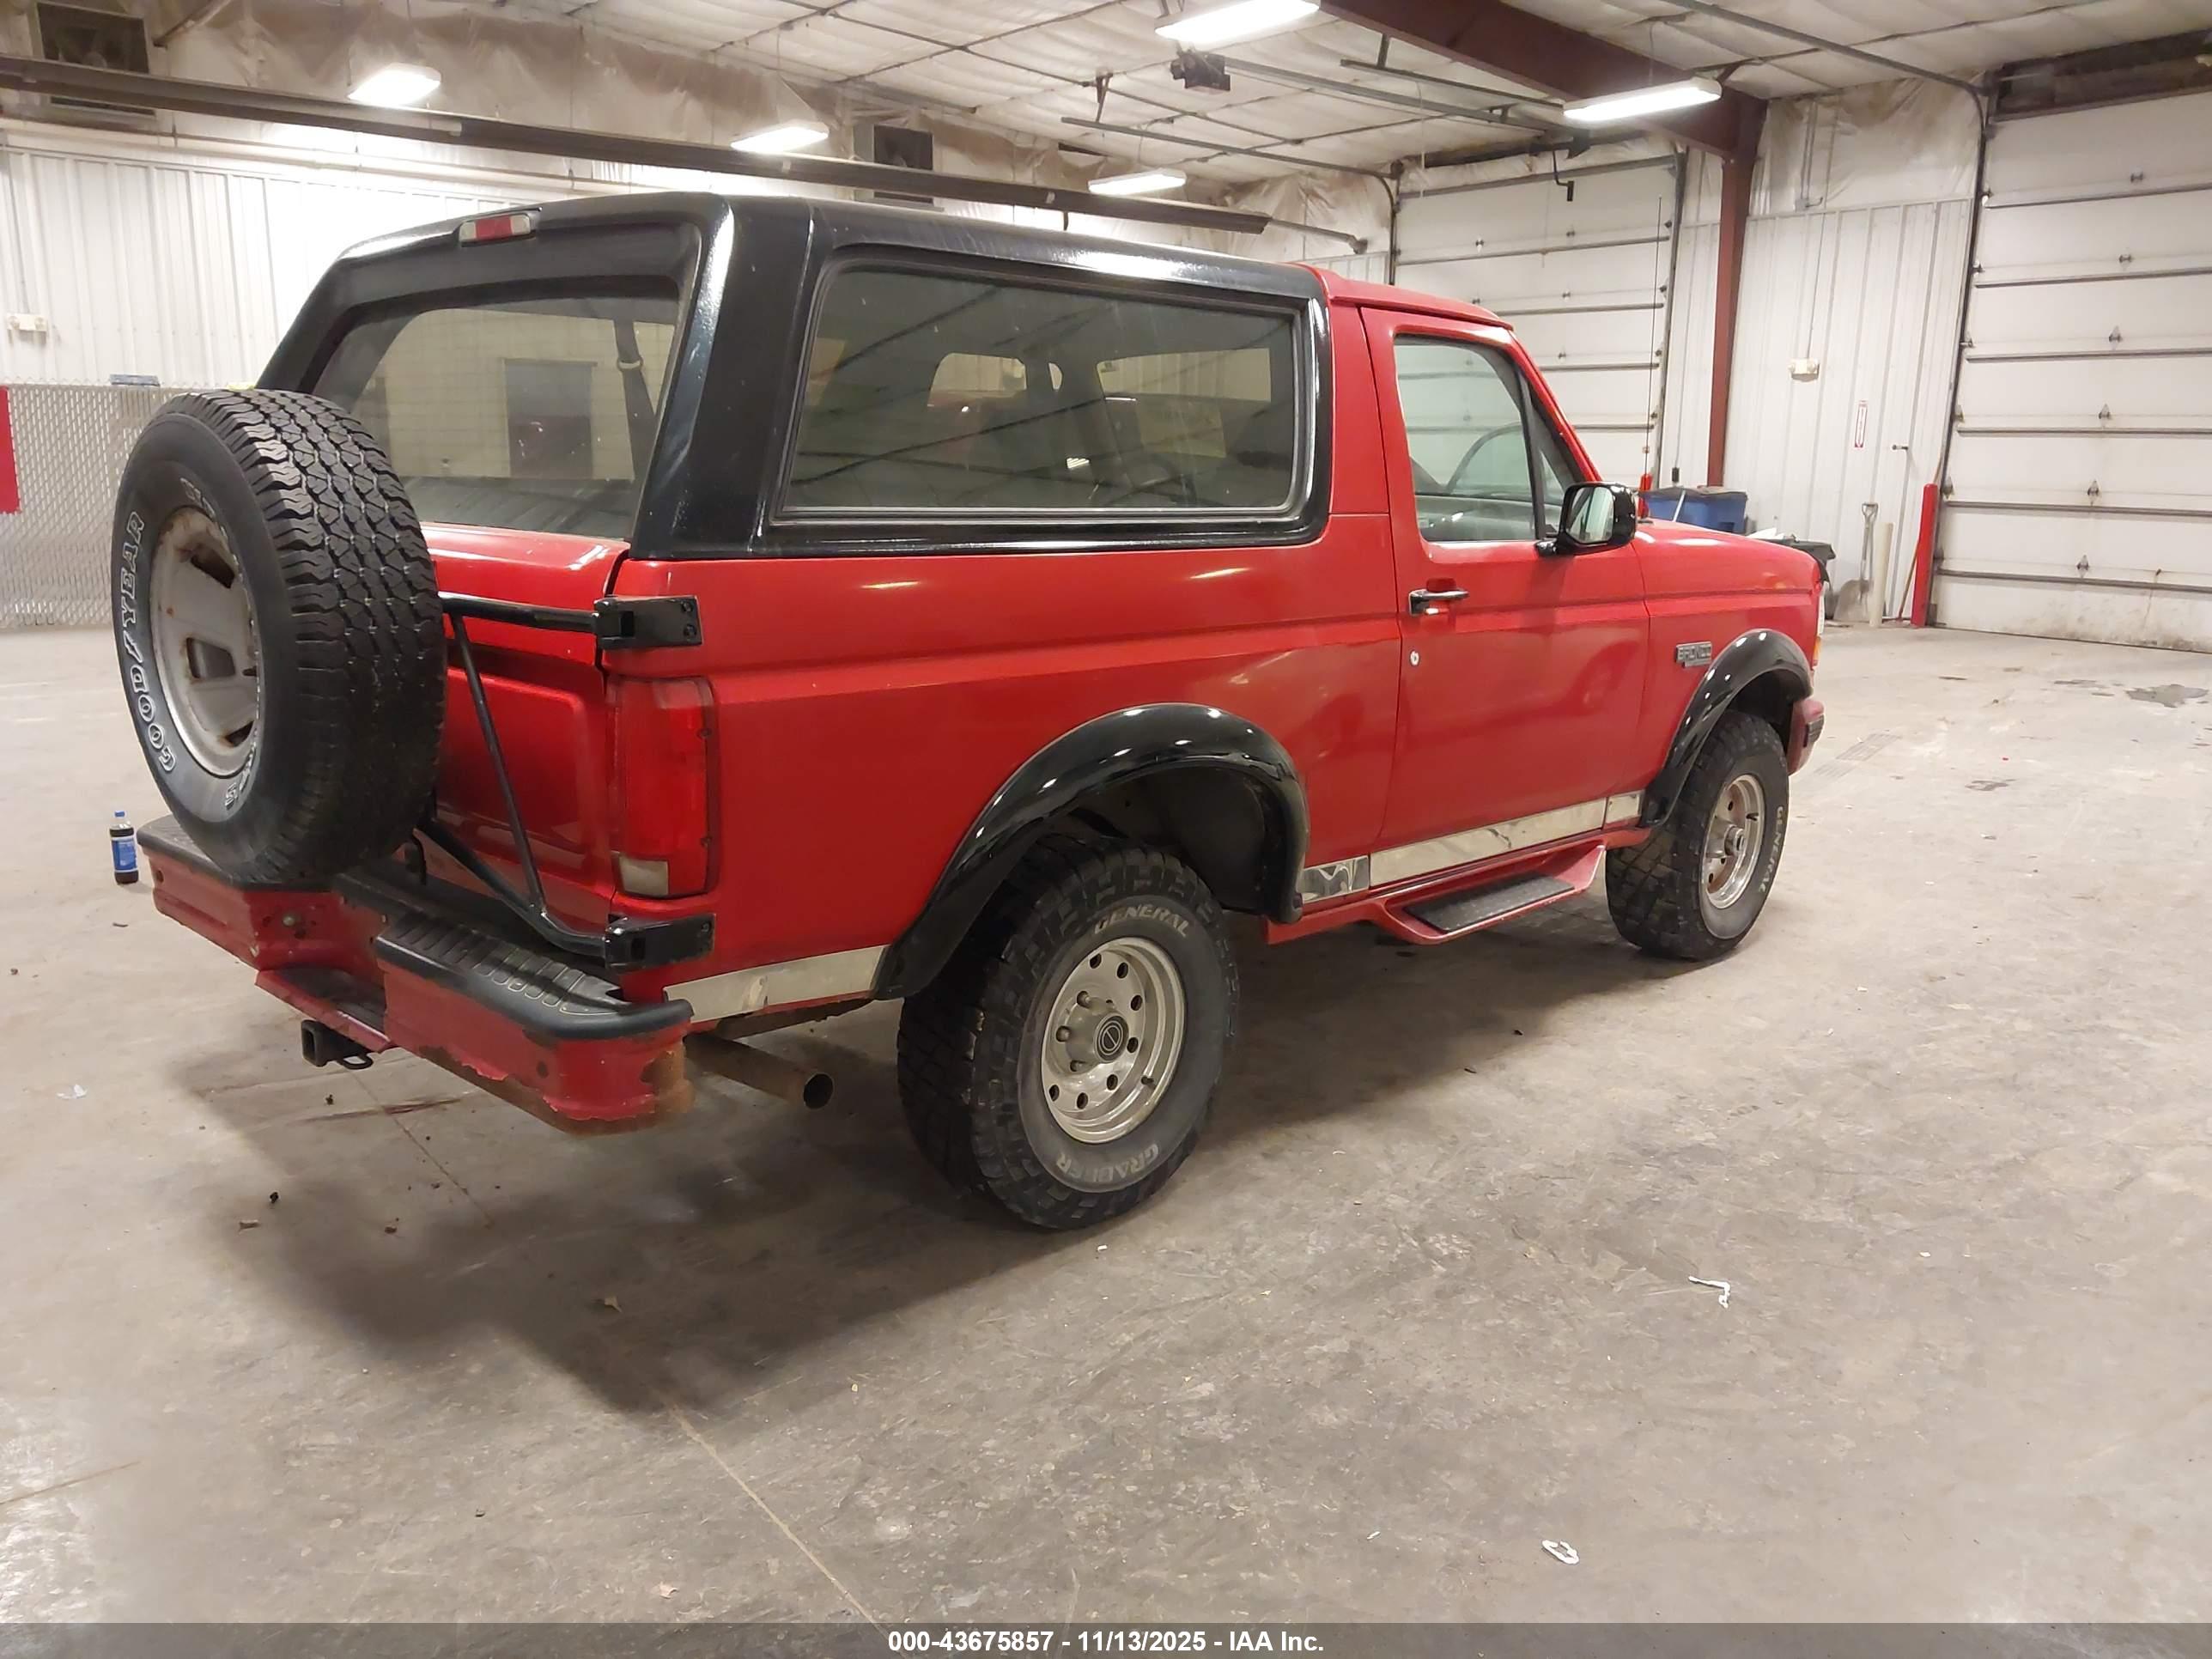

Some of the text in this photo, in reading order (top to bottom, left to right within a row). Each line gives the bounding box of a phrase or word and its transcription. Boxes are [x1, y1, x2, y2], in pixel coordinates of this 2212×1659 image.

[120, 510, 176, 772] GOODYEAR
[1758, 805, 1784, 894] GENERAL
[1094, 903, 1189, 937] GENERAL
